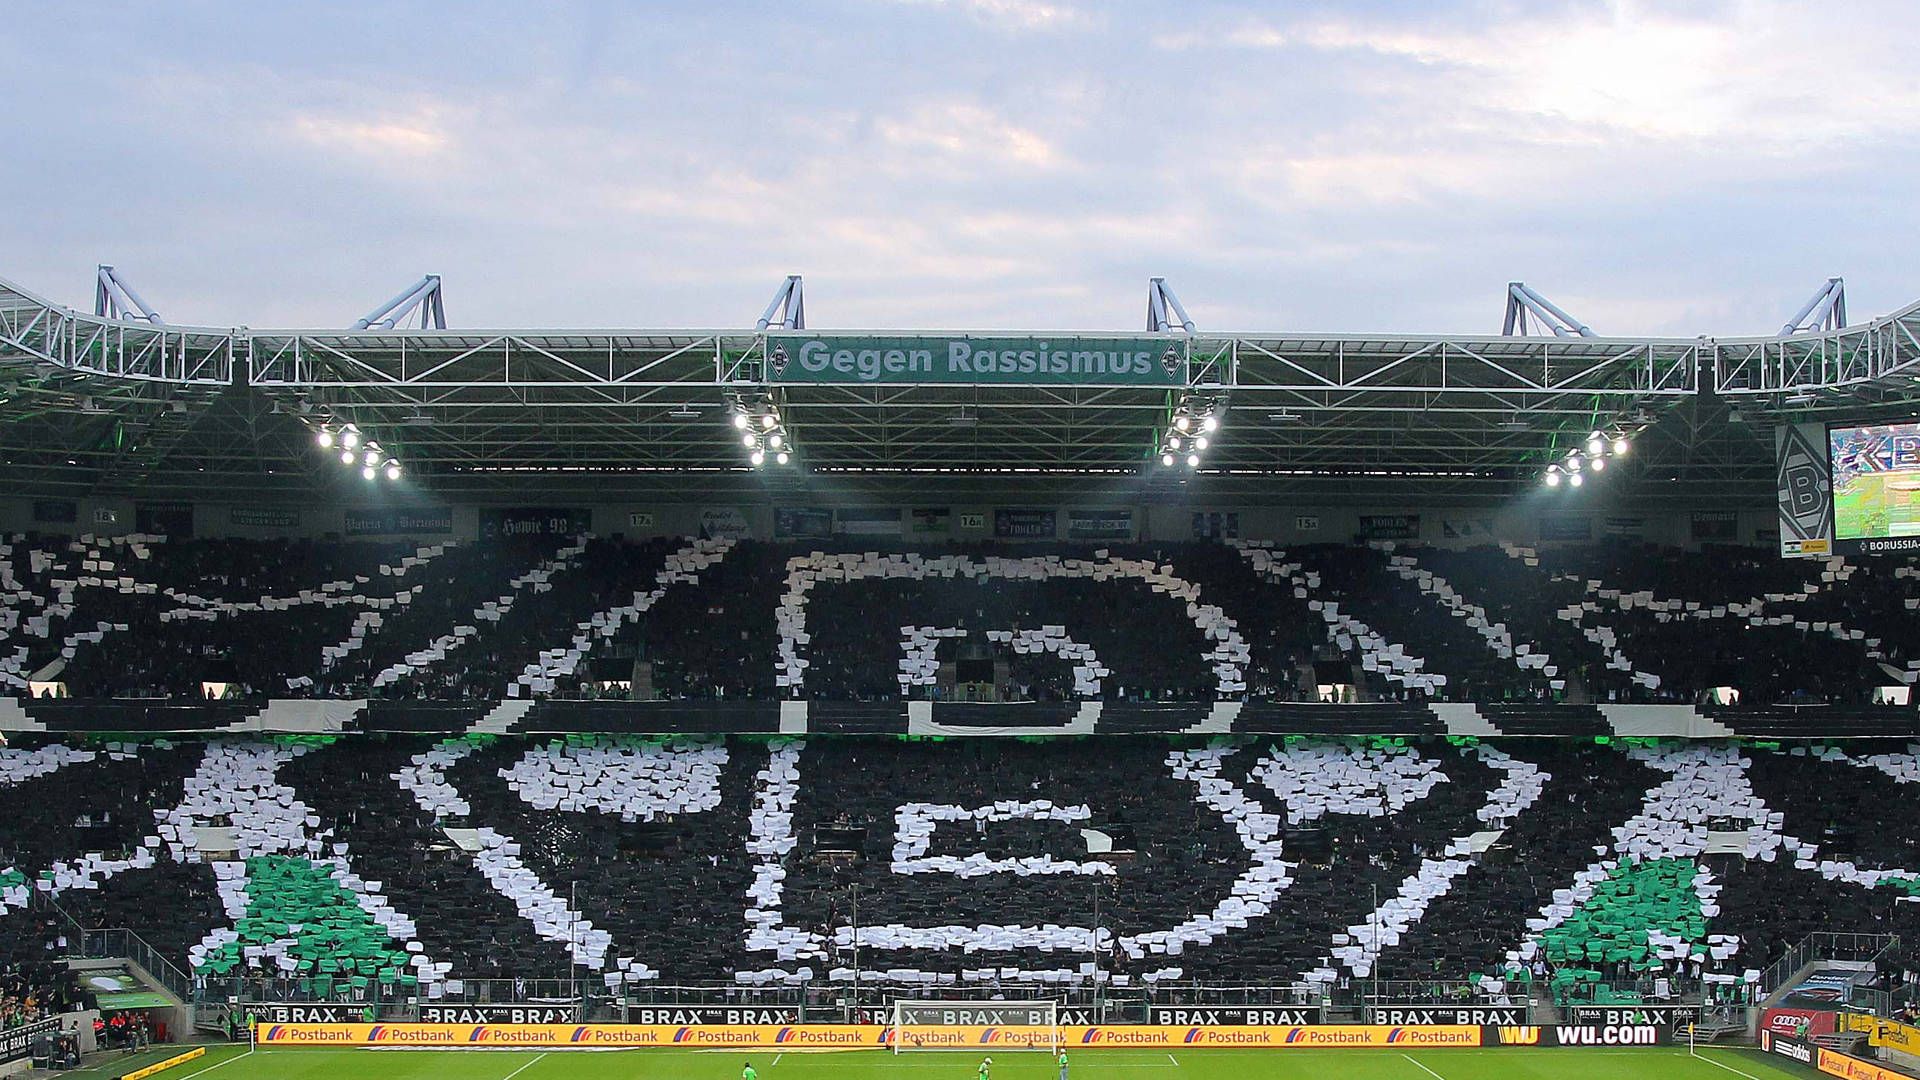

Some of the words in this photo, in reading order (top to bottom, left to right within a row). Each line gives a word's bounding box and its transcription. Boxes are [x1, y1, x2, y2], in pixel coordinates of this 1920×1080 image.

[800, 340, 931, 379] Gegen
[947, 339, 1152, 372] Rassismus
[502, 518, 542, 537] Howie
[276, 1008, 337, 1023] BRAX
[347, 1008, 363, 1016] BRA
[428, 1009, 489, 1024] BRAX
[511, 1009, 573, 1024] BRAX
[641, 1010, 703, 1025] BRAX
[727, 1010, 788, 1025] BRAX
[943, 1010, 1004, 1025] BRAX
[1028, 1010, 1090, 1025] BRAX
[1159, 1010, 1221, 1025] BRAX
[1246, 1010, 1308, 1025] BRAX
[1376, 1010, 1435, 1025] BRAX
[1457, 1010, 1518, 1025] BRAX
[1607, 1010, 1667, 1025] BRAX
[291, 1028, 352, 1042] Postbank
[392, 1029, 454, 1042] Postbank
[494, 1029, 556, 1042] Postbank
[595, 1029, 657, 1042] Postbank
[698, 1029, 760, 1043] Postbank
[800, 1029, 862, 1043] Postbank
[902, 1029, 964, 1043] Postbank
[1005, 1029, 1065, 1043] Postbank
[1107, 1029, 1168, 1043] Postbank
[1209, 1029, 1270, 1043] Postbank
[1310, 1029, 1371, 1043] Postbank
[1411, 1029, 1472, 1043] Postbank
[1498, 1026, 1541, 1045] WU
[1556, 1025, 1656, 1045] wu.com
